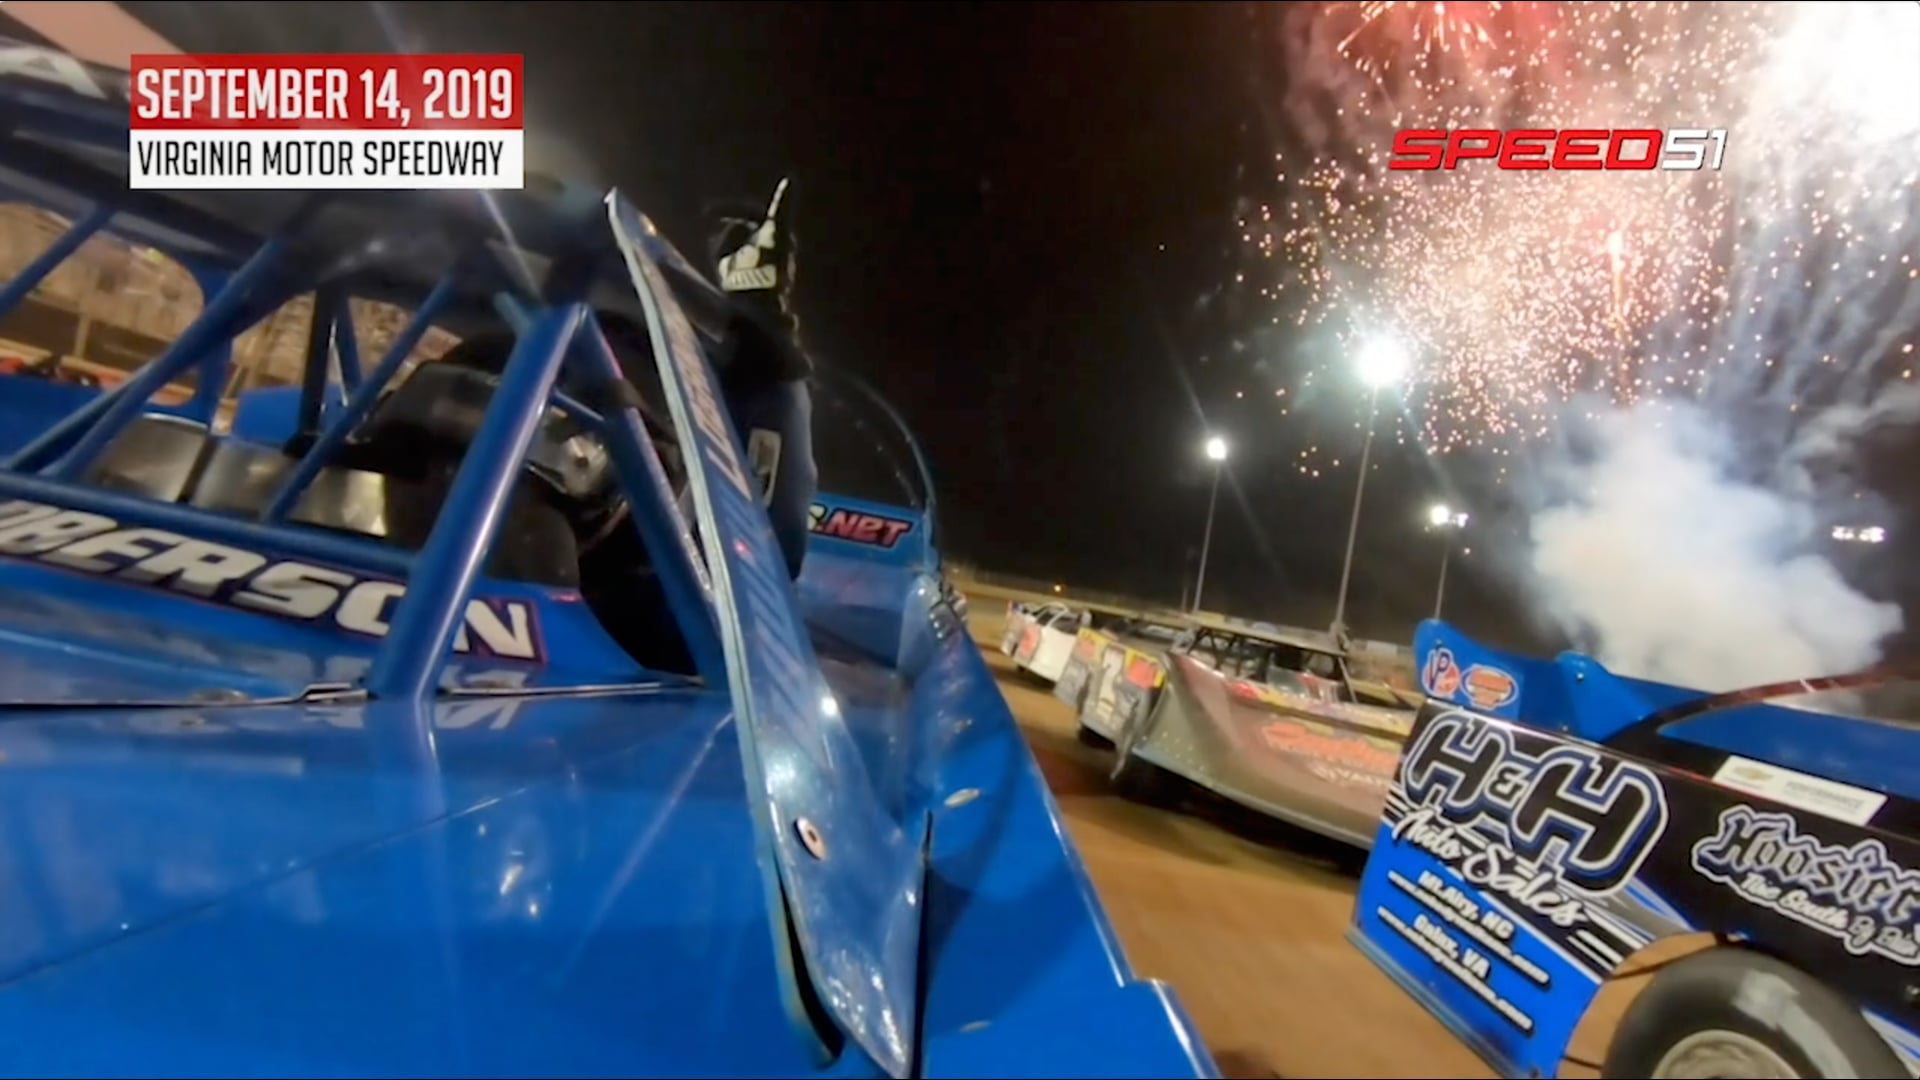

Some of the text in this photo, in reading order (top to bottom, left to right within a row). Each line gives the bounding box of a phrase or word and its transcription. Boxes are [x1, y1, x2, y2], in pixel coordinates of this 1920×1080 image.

[1404, 707, 1668, 896] H&H
[1391, 806, 1464, 861] Auto
[1461, 842, 1590, 927] Sales
[1462, 947, 1491, 980] VA
[1481, 910, 1516, 940] NC
